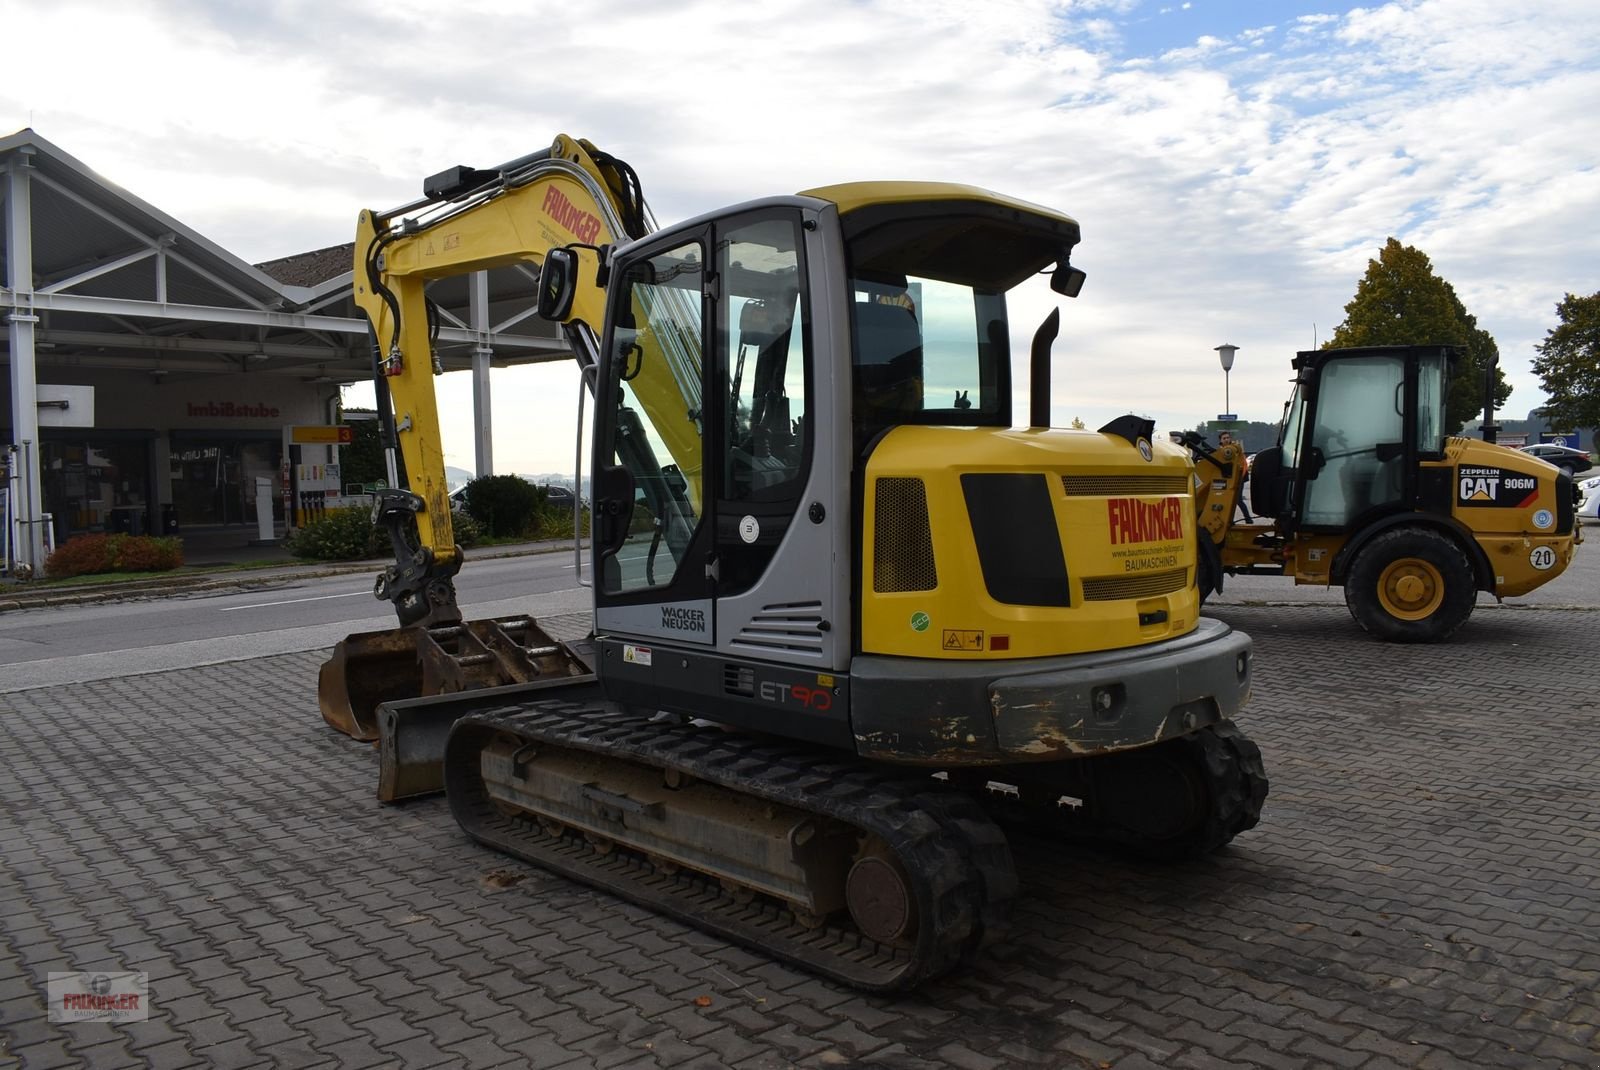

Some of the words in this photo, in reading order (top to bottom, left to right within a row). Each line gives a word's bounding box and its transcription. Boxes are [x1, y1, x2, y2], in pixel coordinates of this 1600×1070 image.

[543, 184, 602, 245] FALKINGER
[186, 402, 280, 418] Imbißstube
[341, 430, 351, 443] 3
[1460, 478, 1500, 500] CAT
[1504, 478, 1535, 489] 906M
[1107, 497, 1183, 545] FALKINGER
[1124, 556, 1178, 572] BAUMASCHINEN
[1535, 550, 1551, 566] 20
[661, 606, 705, 621] WACKER
[662, 618, 705, 633] NEUSON
[911, 614, 929, 630] ECO
[760, 681, 832, 710] ET90
